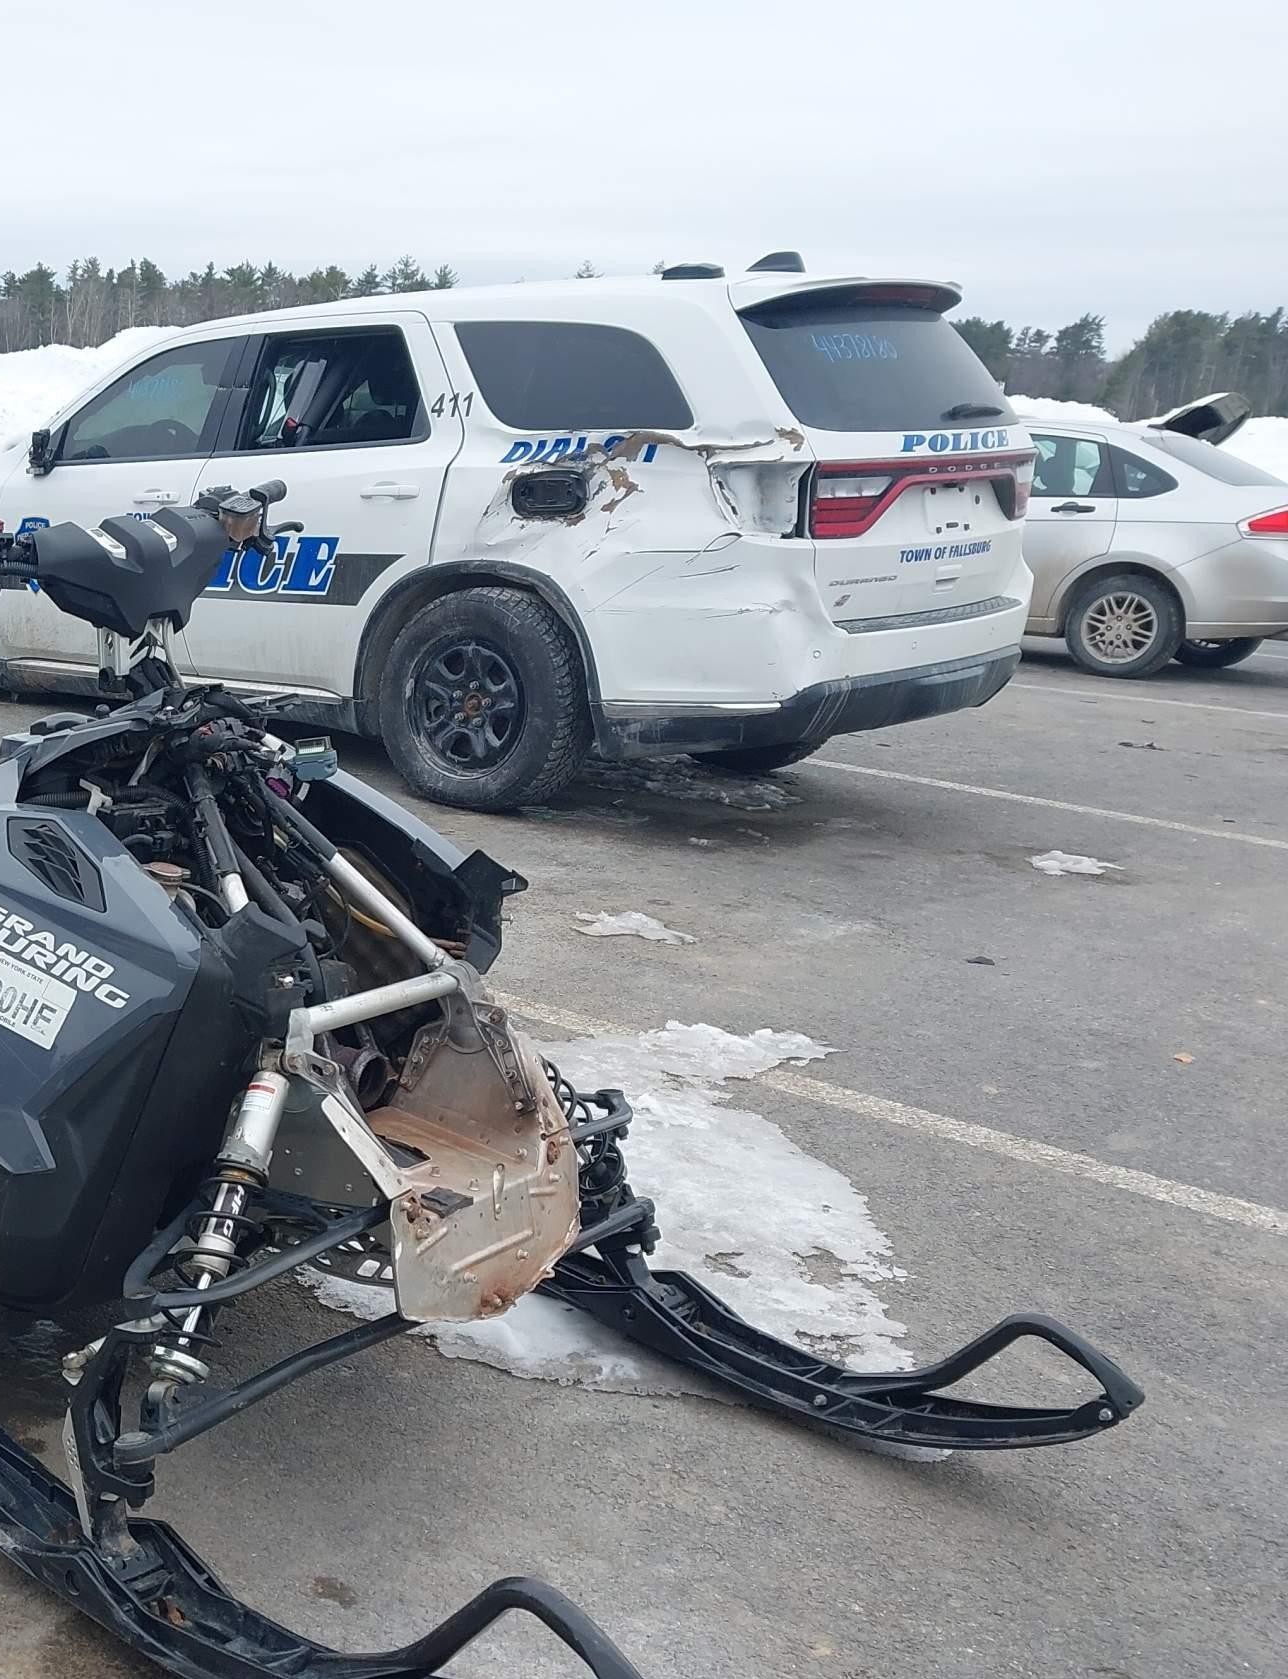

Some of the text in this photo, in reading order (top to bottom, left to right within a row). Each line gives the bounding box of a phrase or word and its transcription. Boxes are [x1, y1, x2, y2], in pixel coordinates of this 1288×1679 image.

[430, 391, 474, 418] 411
[899, 429, 1009, 453] POLICE
[899, 540, 992, 564] TOWN OF FALLSBURG
[11, 964, 26, 977] YORK
[26, 971, 43, 985] STATE
